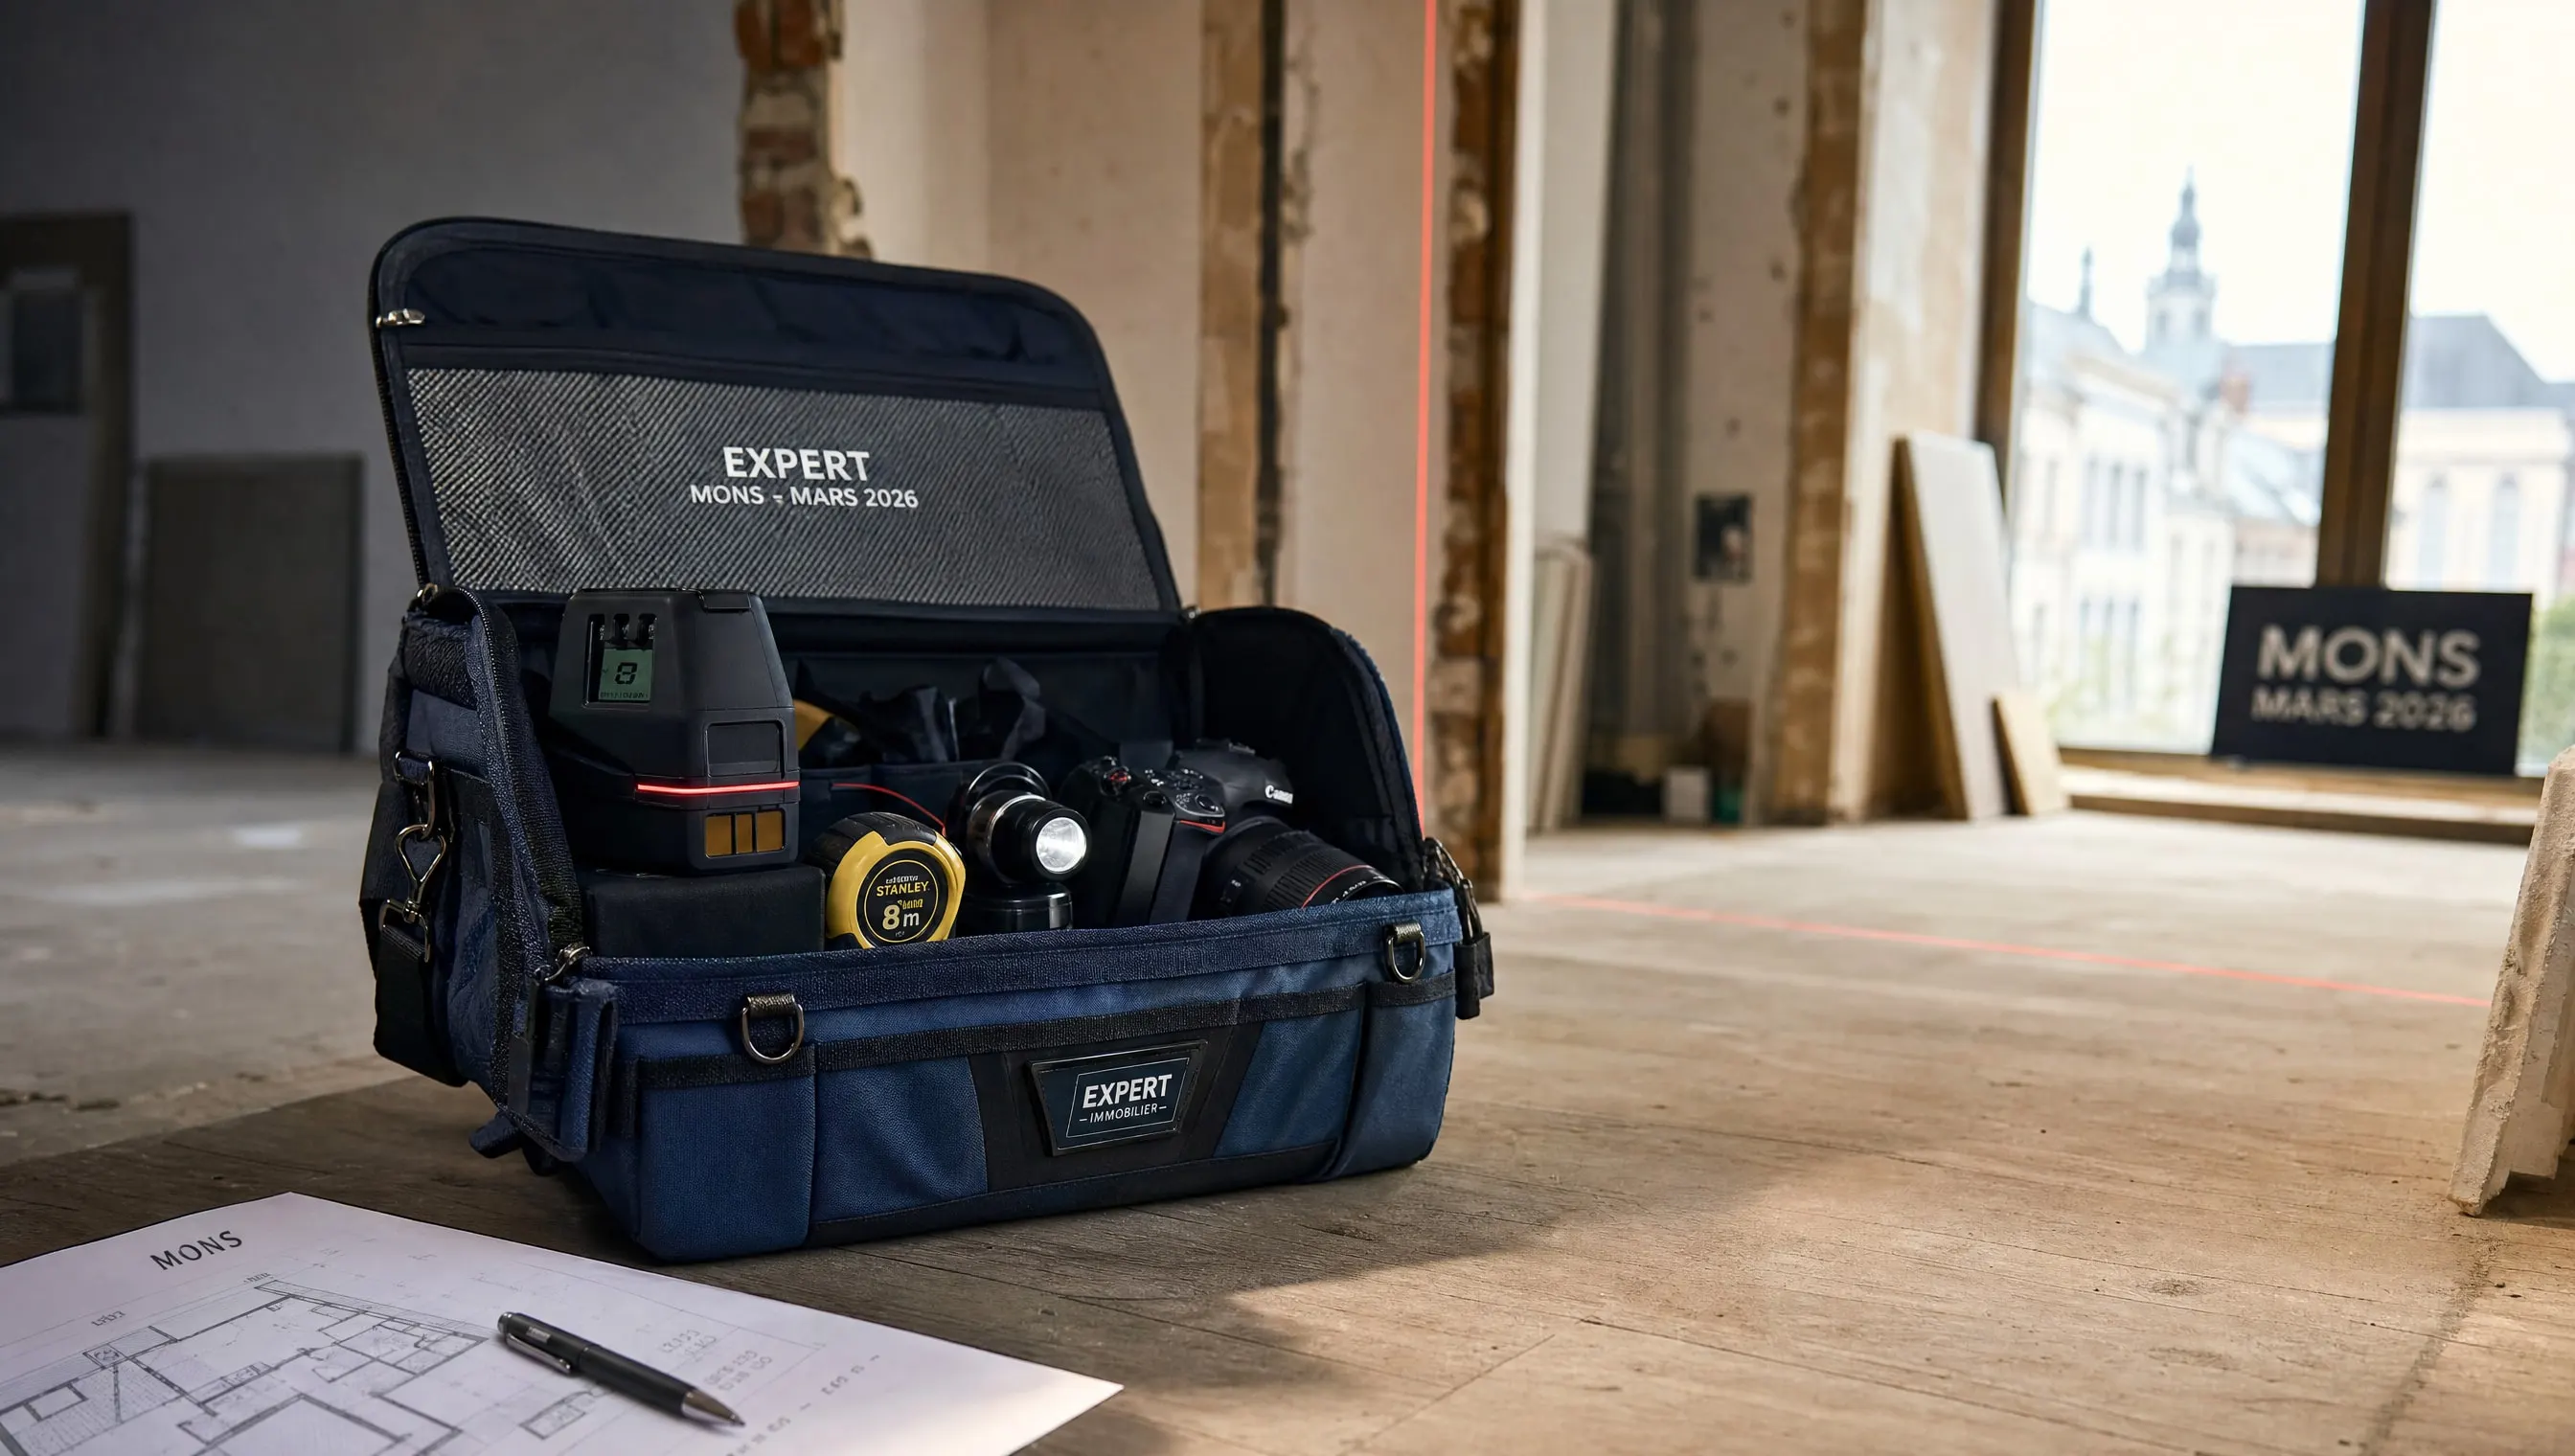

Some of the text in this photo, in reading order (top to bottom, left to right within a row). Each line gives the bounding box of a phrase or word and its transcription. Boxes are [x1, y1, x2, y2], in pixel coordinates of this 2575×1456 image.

[722, 446, 870, 481] EXPERT
[690, 484, 764, 505] MONS
[789, 486, 858, 507] MARS
[863, 488, 919, 509] 2026
[614, 661, 638, 685] 8
[2257, 625, 2480, 688] MONS
[2250, 688, 2368, 726] MARS
[876, 880, 929, 897] STANLEY
[1082, 1073, 1173, 1109] EXPERT
[149, 1230, 242, 1271] MONS
